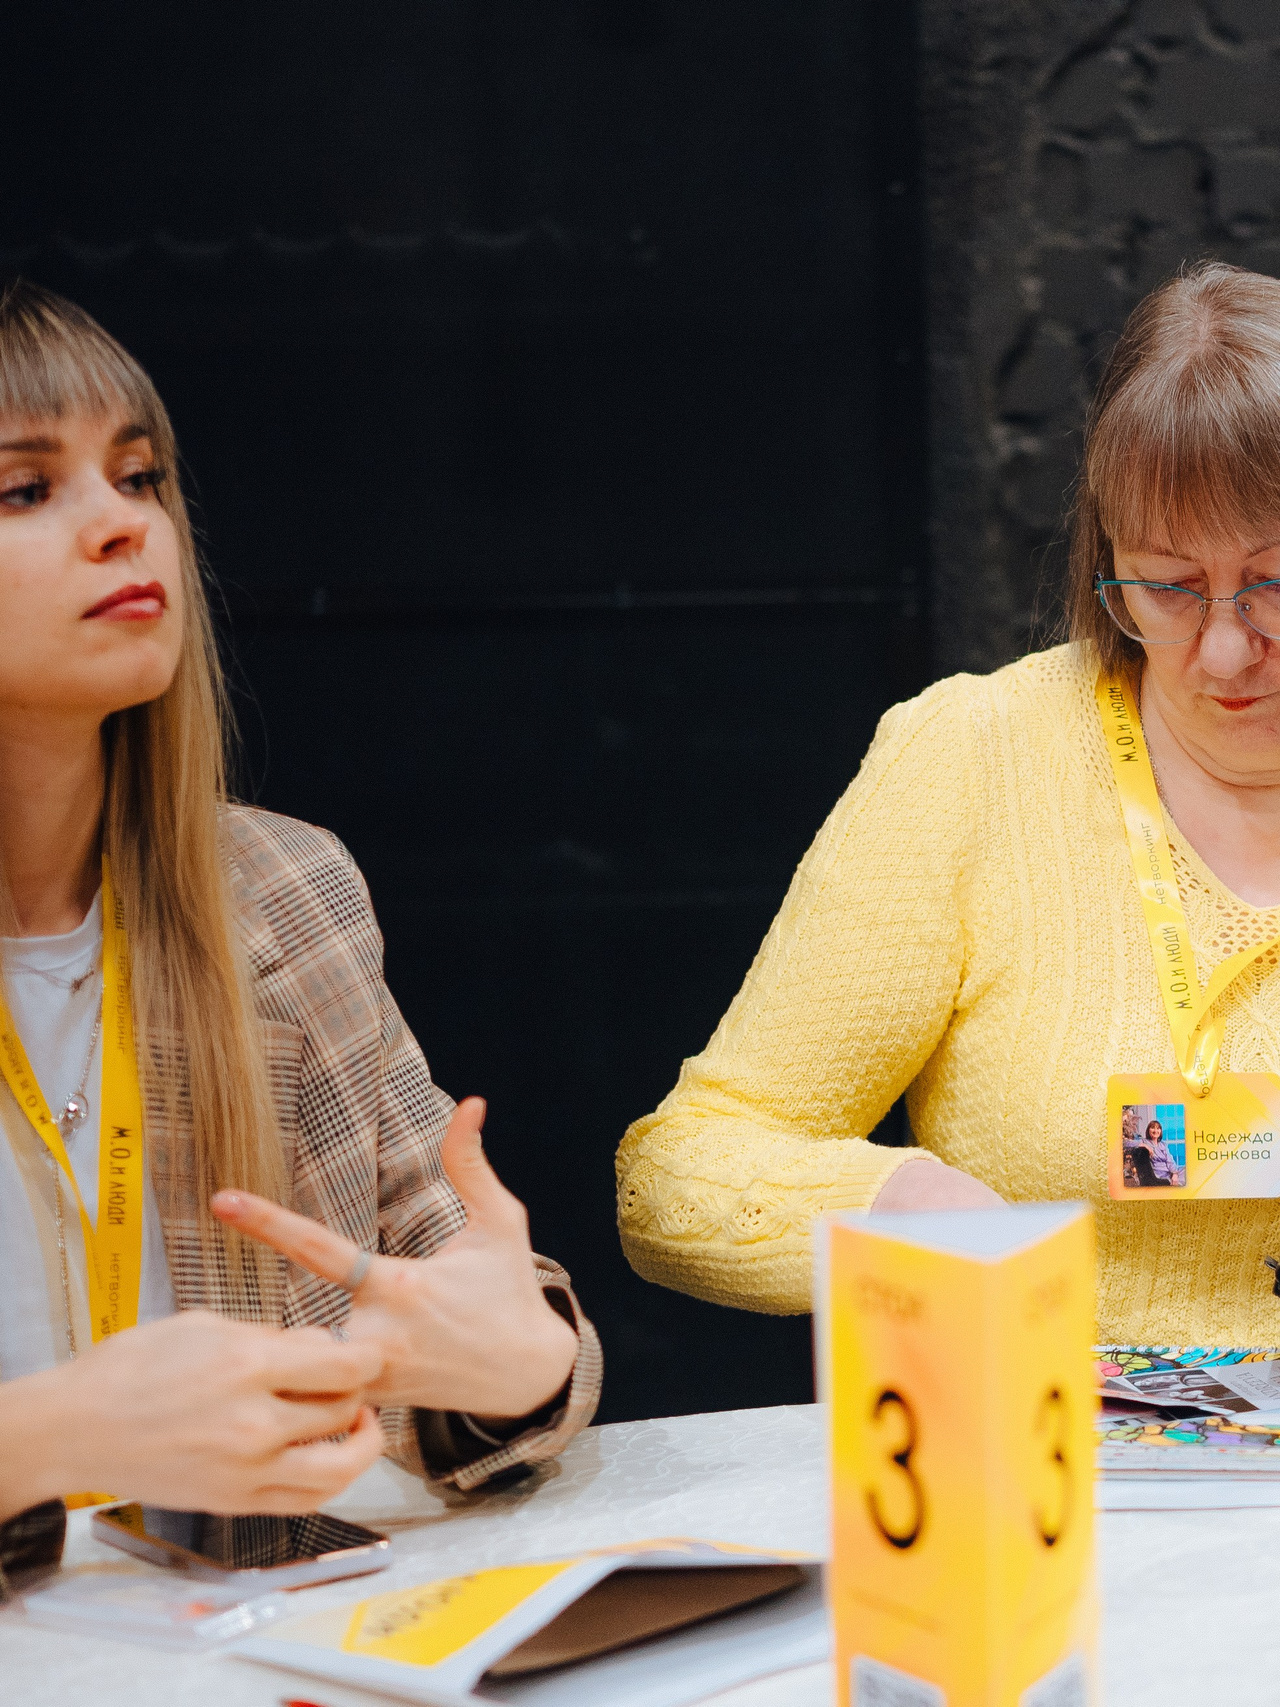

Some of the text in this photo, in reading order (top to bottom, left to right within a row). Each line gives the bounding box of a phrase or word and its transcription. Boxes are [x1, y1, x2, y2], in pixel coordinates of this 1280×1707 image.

[1141, 823, 1166, 905] нетворкинг
[1194, 1130, 1273, 1144] Надежда
[1197, 1147, 1271, 1161] Ванкова
[864, 1384, 929, 1551] 3
[1030, 1383, 1076, 1550] 3
